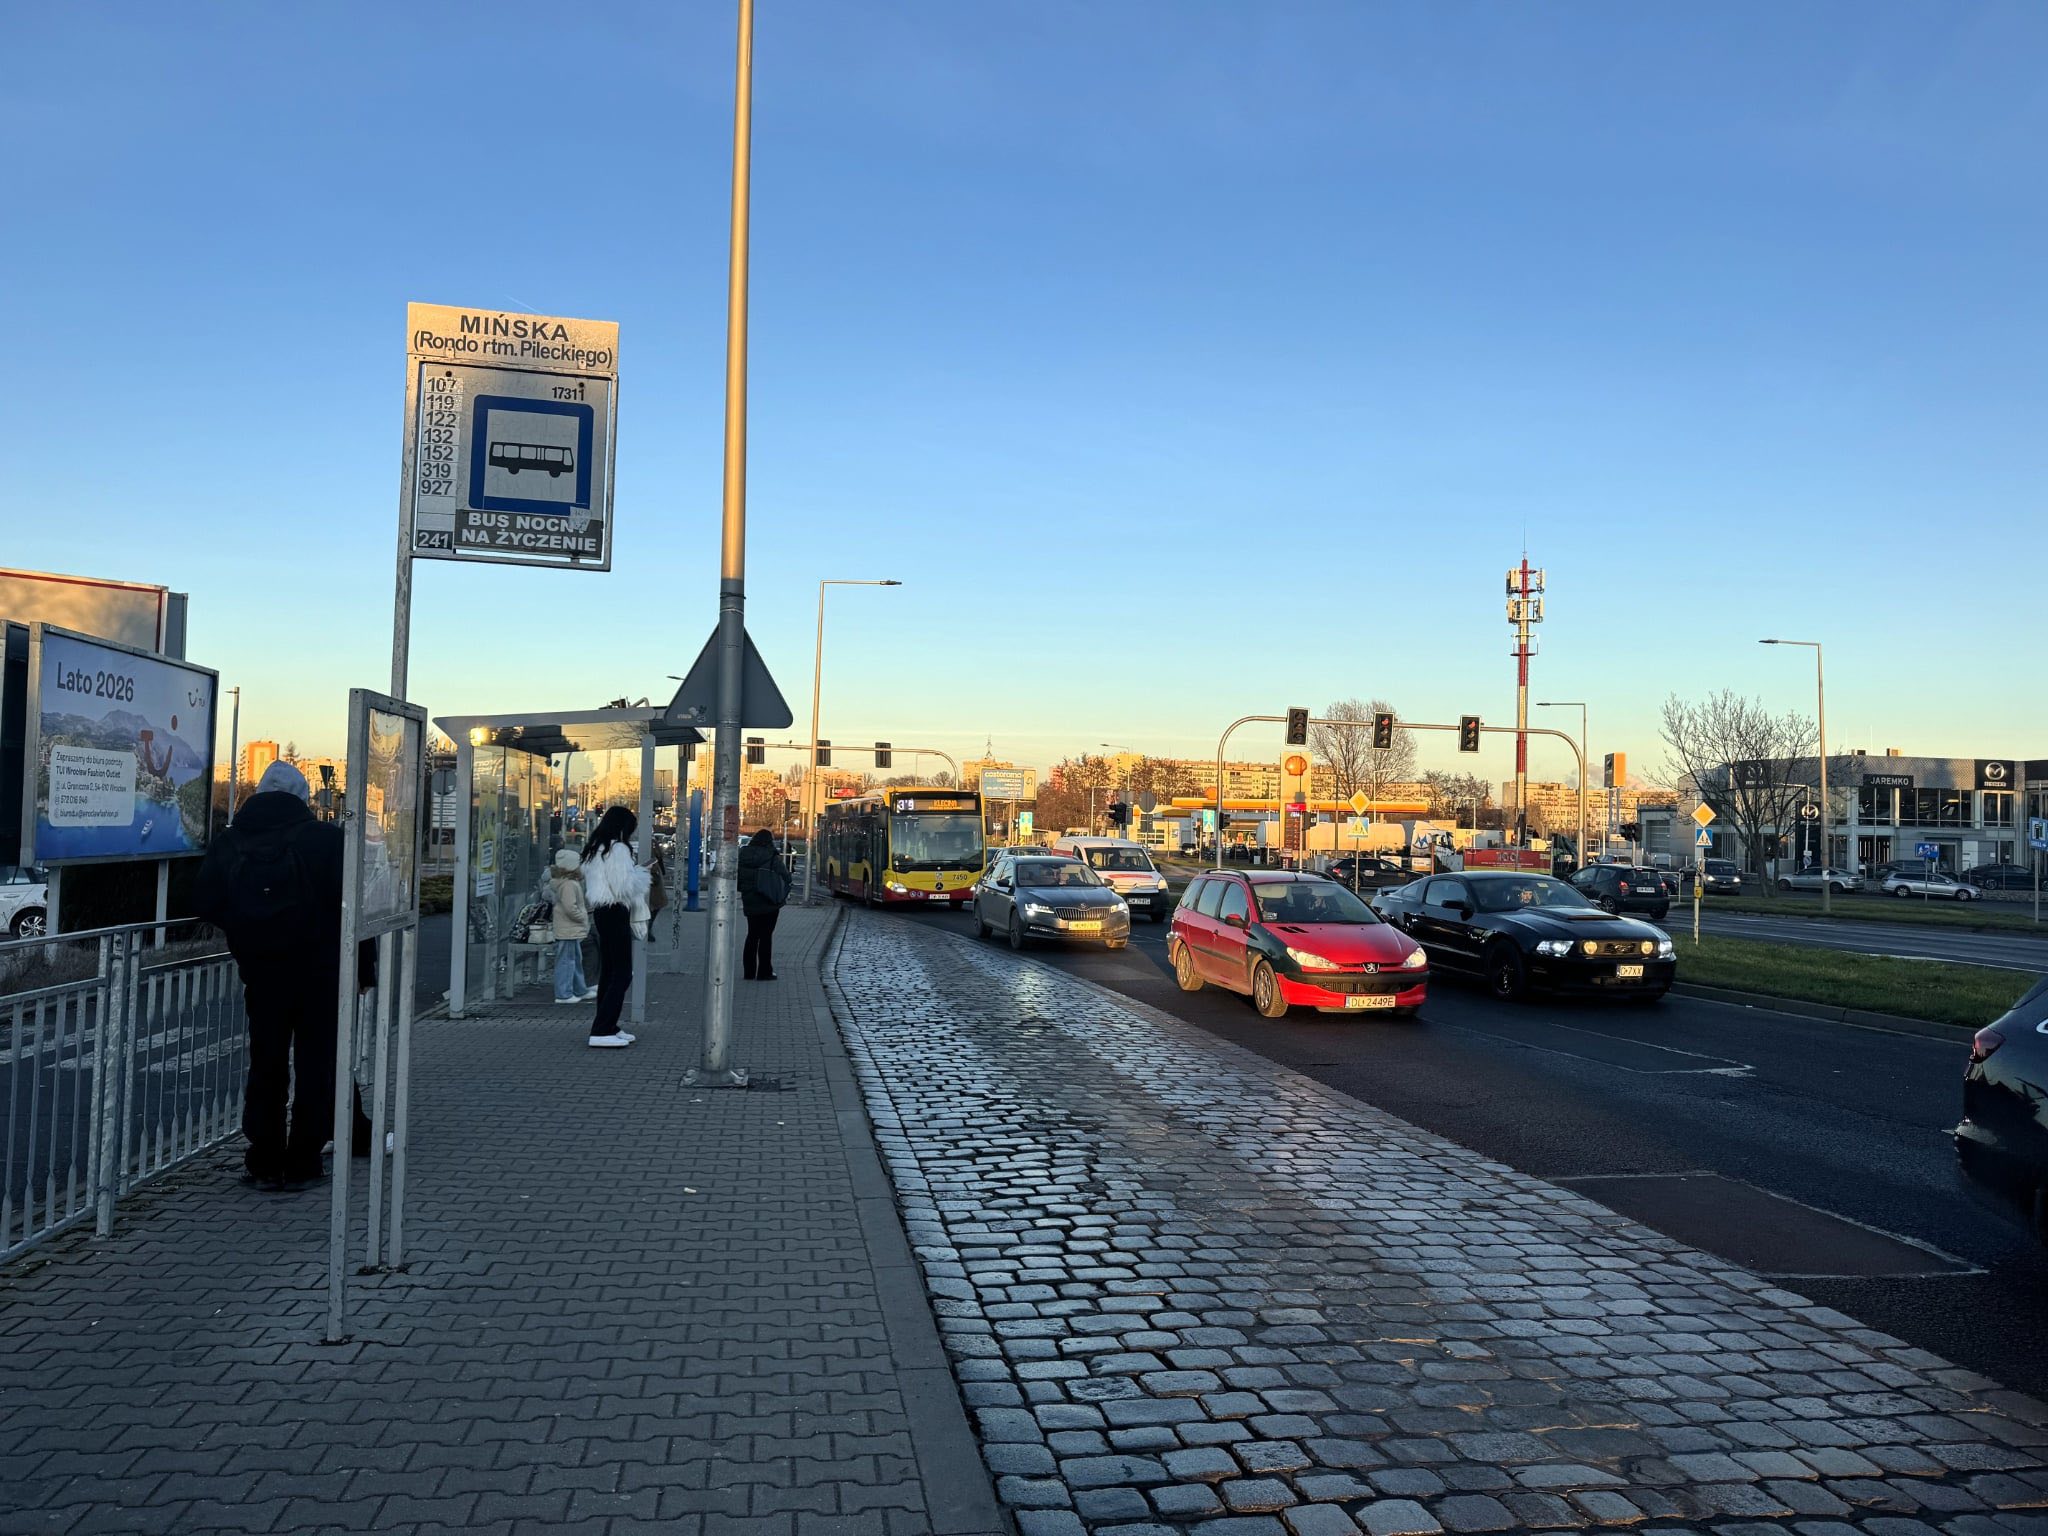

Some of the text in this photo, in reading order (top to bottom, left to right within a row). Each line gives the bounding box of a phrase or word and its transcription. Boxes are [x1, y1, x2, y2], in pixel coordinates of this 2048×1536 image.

[460, 314, 569, 342] MIŃSKA
[413, 330, 479, 353] (Rondo
[427, 377, 456, 392] 107
[551, 386, 585, 401] 17311
[426, 394, 455, 410] 119
[426, 411, 456, 428] 122
[424, 428, 453, 444] 132
[424, 445, 453, 461] 152
[422, 462, 451, 478] 319
[421, 479, 453, 495] 927
[468, 512, 510, 528] BUS
[418, 532, 449, 549] 241
[461, 528, 597, 552] NA ŻYCZENIE
[57, 661, 134, 702] Lato 2026
[1870, 777, 1909, 786] JAREMKO
